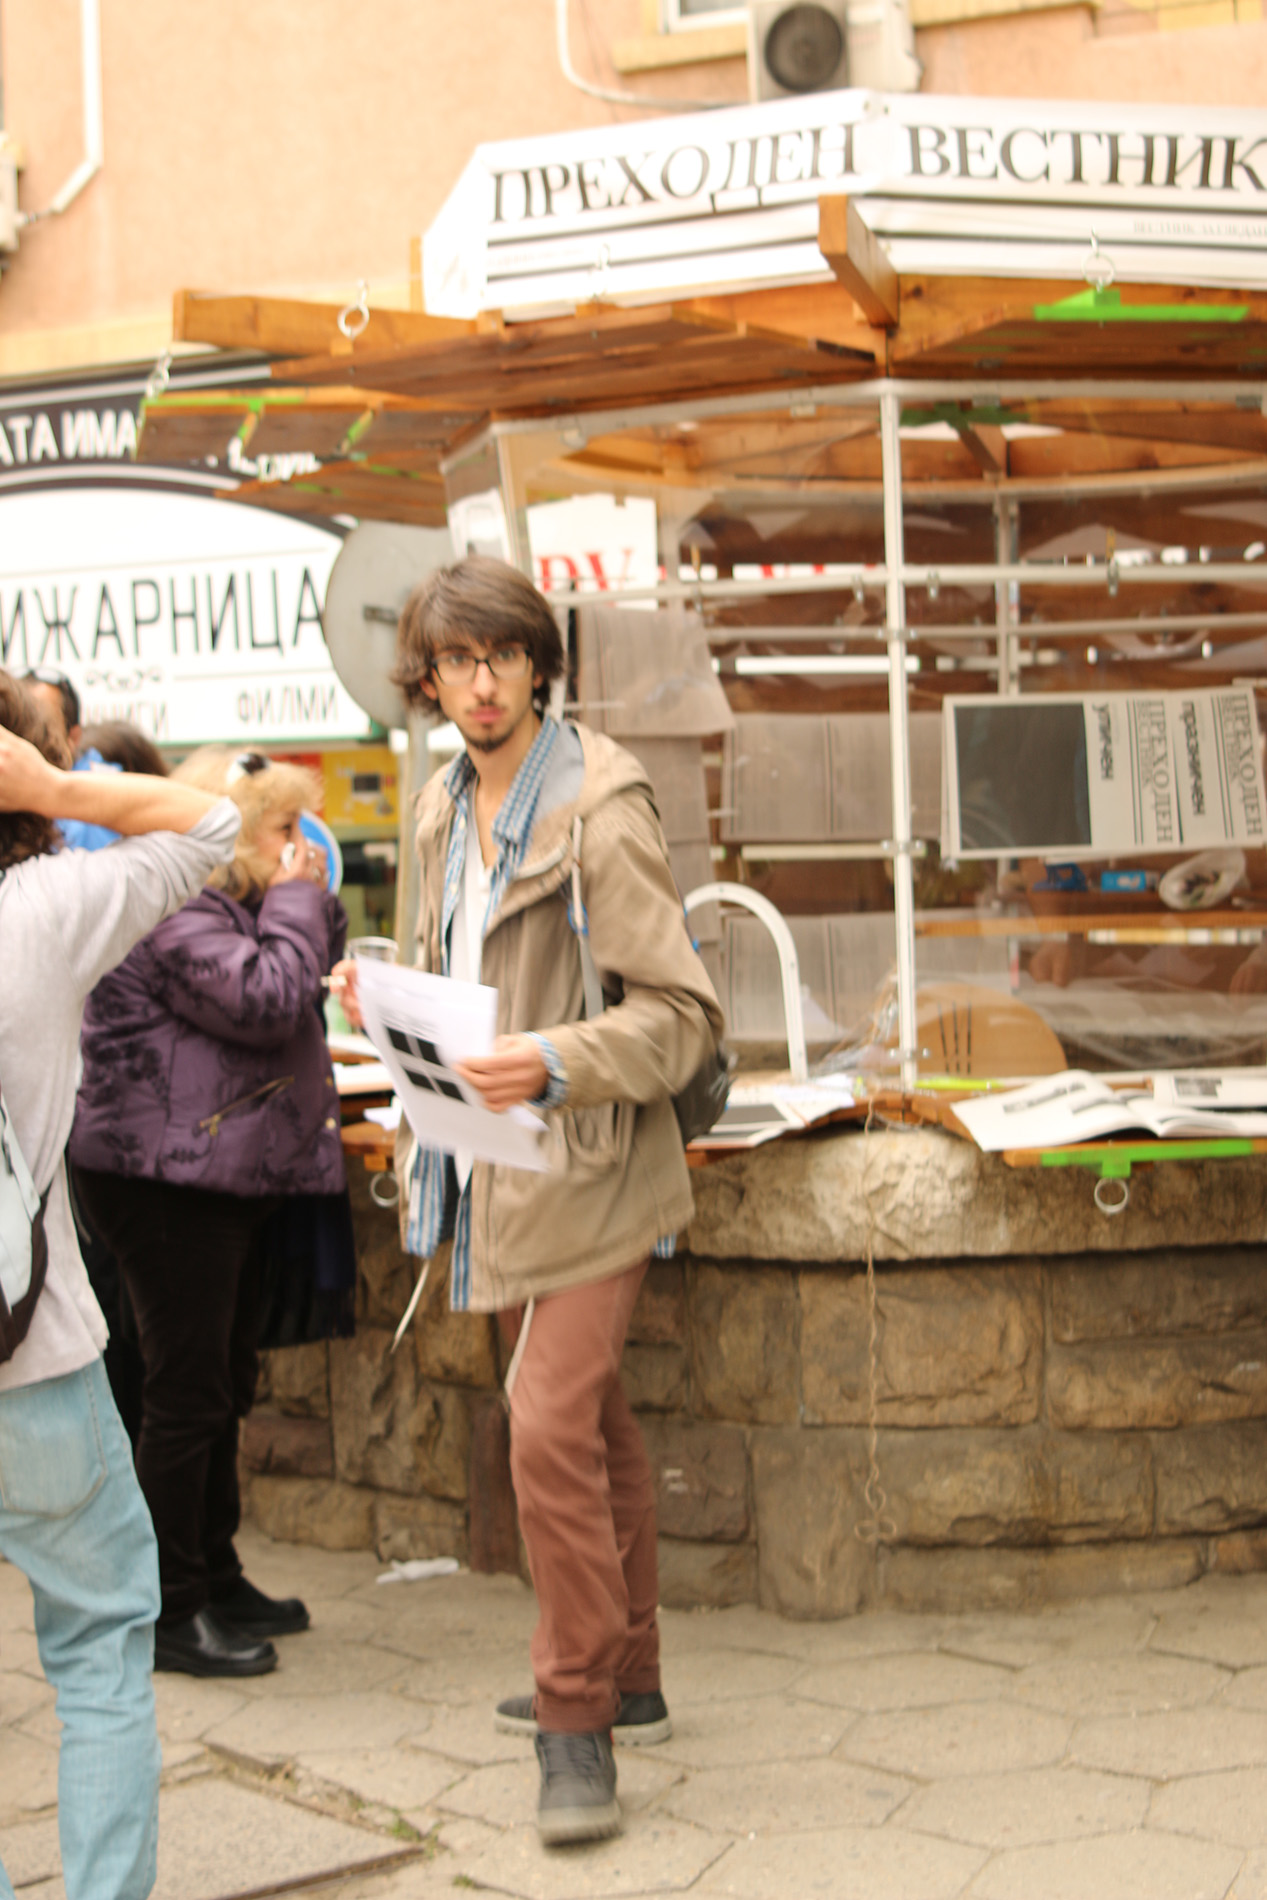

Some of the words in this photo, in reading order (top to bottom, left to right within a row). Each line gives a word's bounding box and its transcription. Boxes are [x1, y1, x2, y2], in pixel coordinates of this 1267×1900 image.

[490, 121, 857, 223] ПРЕХОДЕН
[907, 123, 1267, 192] ВЕСТНИК
[0, 566, 328, 663] ИЖАРНИЦА
[237, 685, 338, 724] ФИЛМИ
[1149, 700, 1174, 843] ПРЕХОДЕН
[1233, 693, 1263, 836] ПРЕХОДЕН
